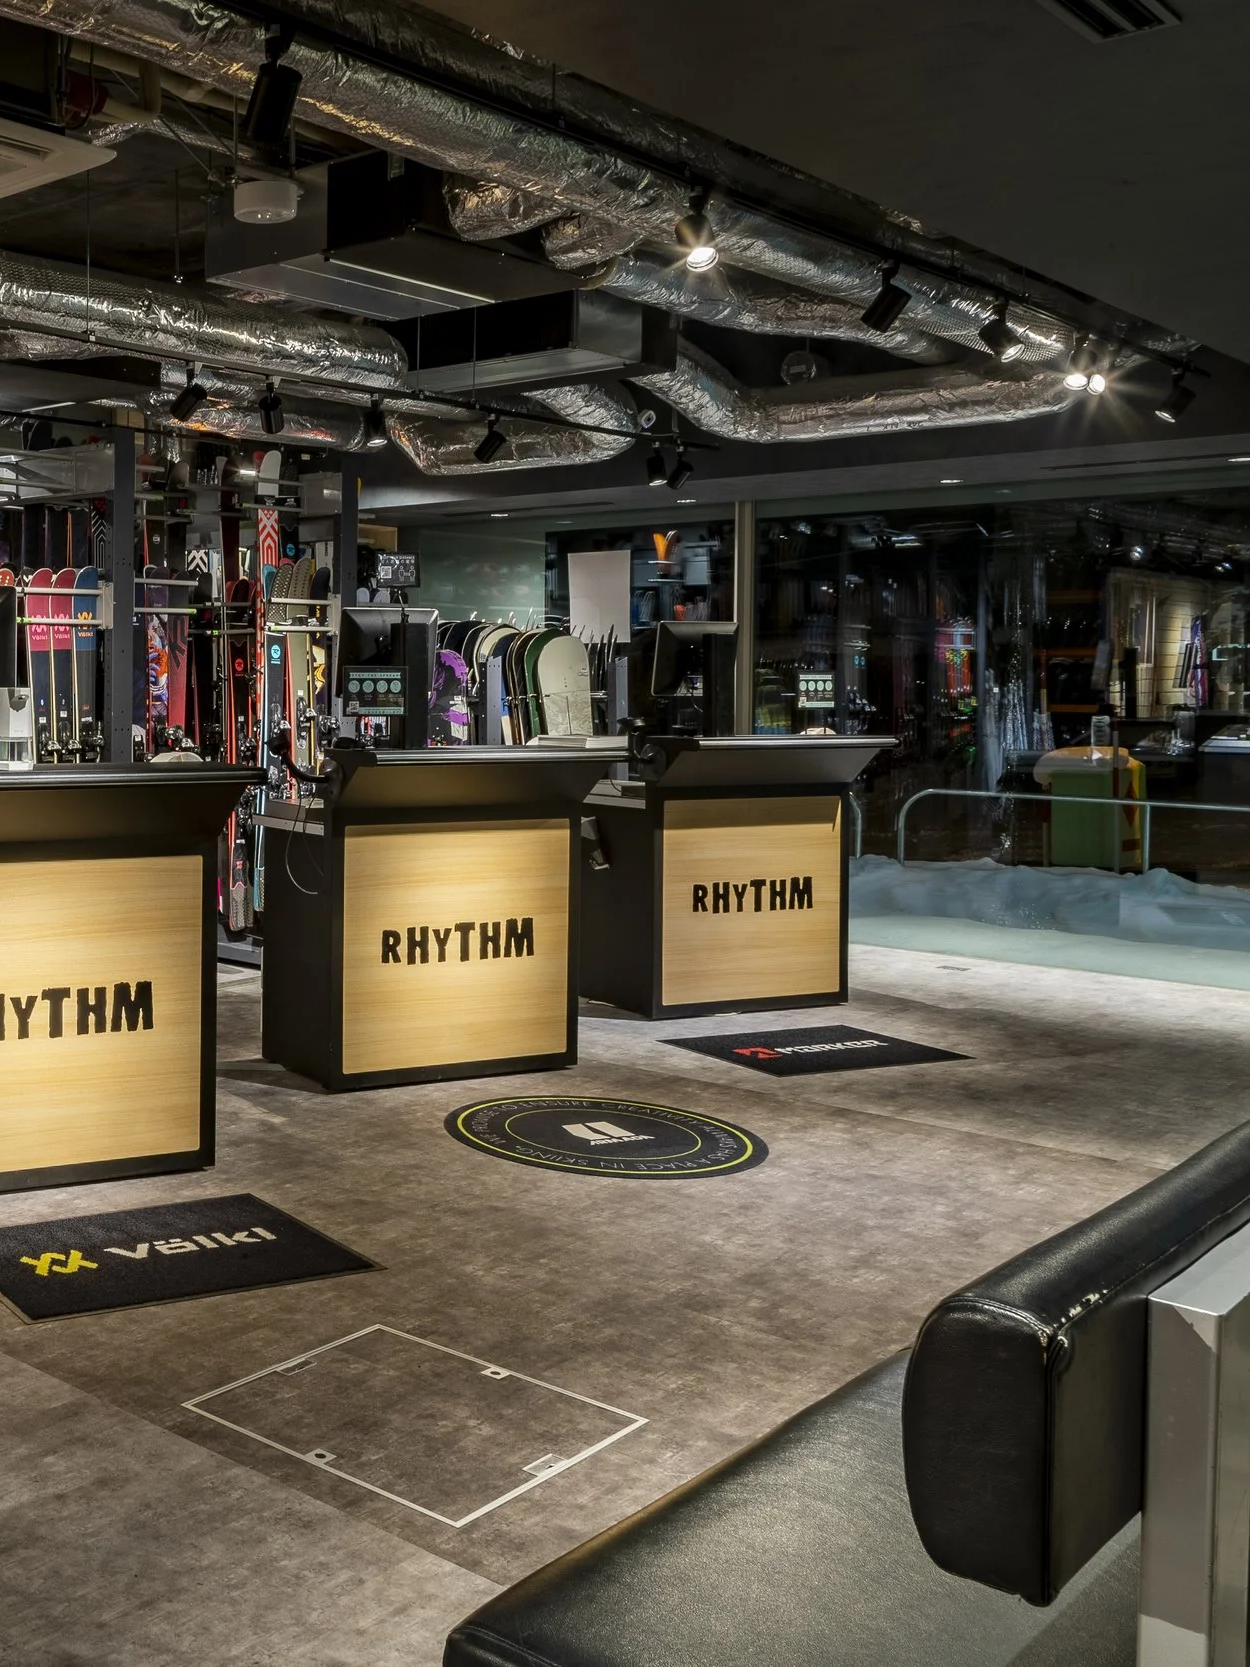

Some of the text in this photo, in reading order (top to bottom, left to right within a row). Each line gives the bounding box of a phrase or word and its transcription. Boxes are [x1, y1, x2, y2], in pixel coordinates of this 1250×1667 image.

[691, 875, 814, 915] RHYTHM
[381, 916, 535, 966] RHYTHM
[774, 1039, 889, 1055] MARKER
[520, 1100, 591, 1108] ENSURE
[601, 1102, 698, 1125] CREATIVITY
[590, 1135, 656, 1146] ARMADA
[599, 1161, 625, 1169] IN
[634, 1160, 698, 1170] PLACE
[104, 1226, 278, 1262] Völkl
